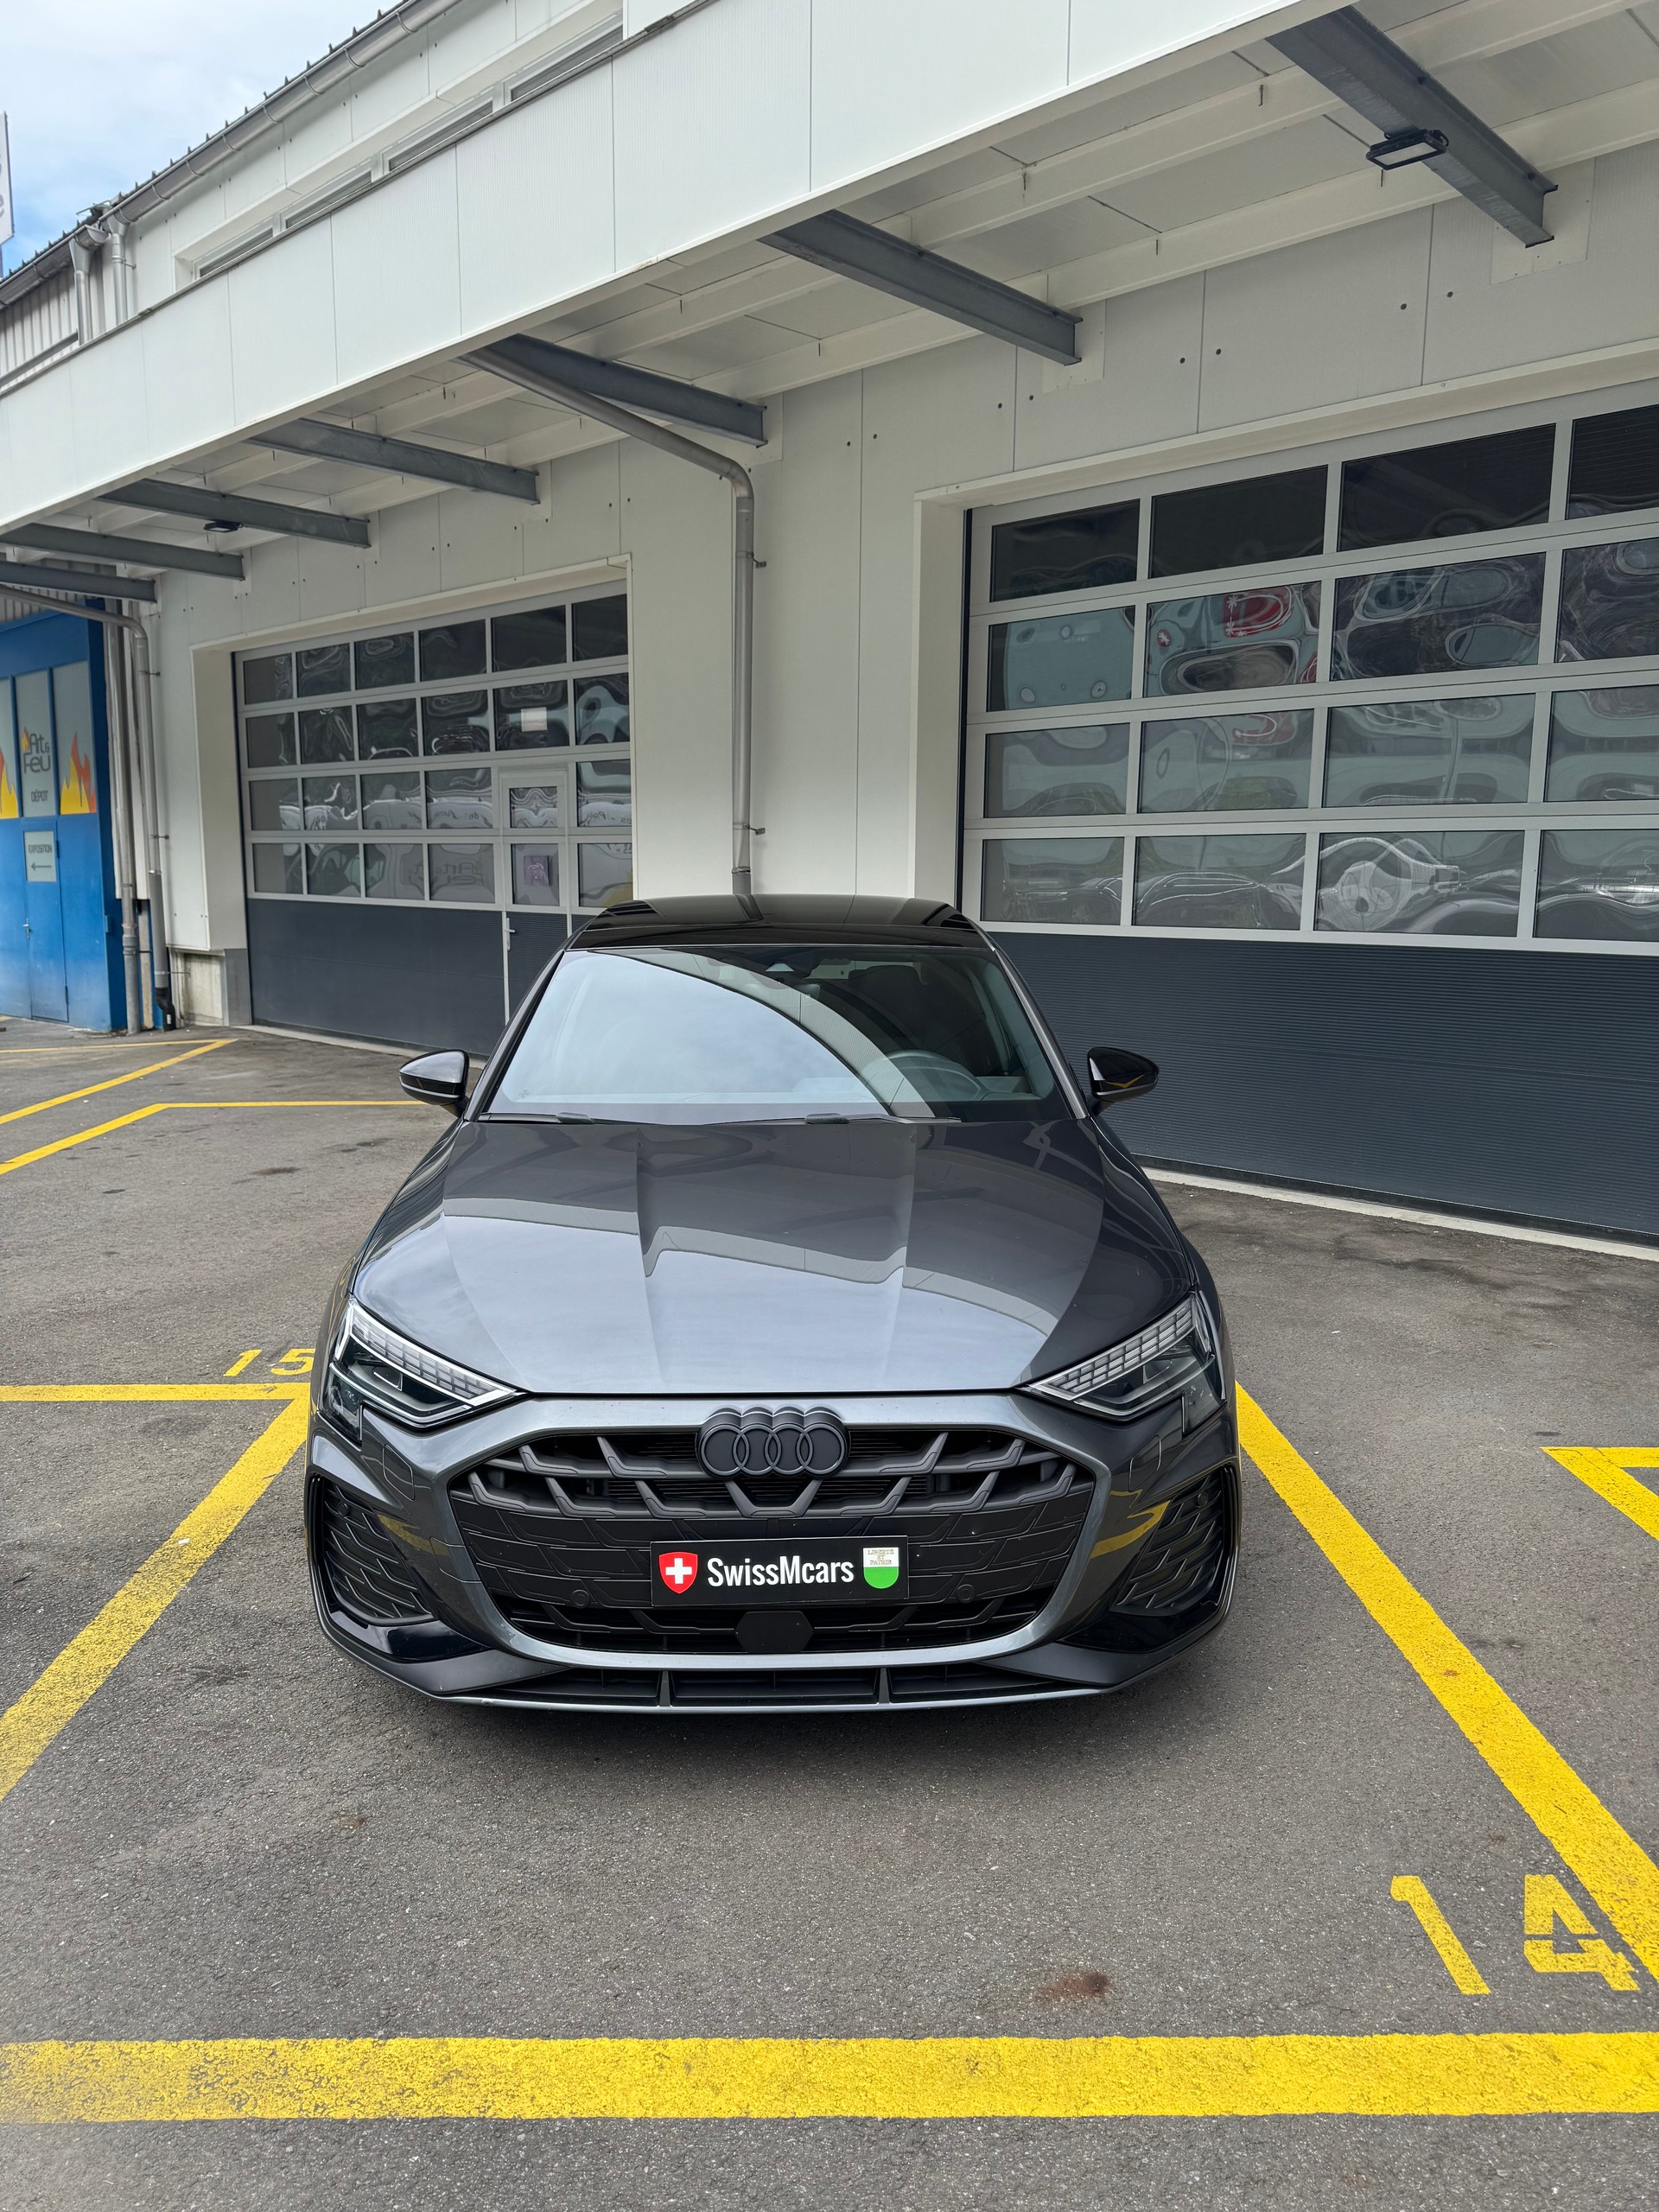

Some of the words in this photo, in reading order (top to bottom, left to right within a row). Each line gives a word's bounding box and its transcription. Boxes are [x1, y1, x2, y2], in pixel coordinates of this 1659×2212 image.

[29, 733, 44, 754] Art
[31, 789, 48, 802] DÉPOT
[28, 843, 53, 854] EXPOSITION
[223, 1349, 315, 1376] 15
[707, 1555, 855, 1587] SwissMcars
[1390, 1873, 1640, 1995] 14
